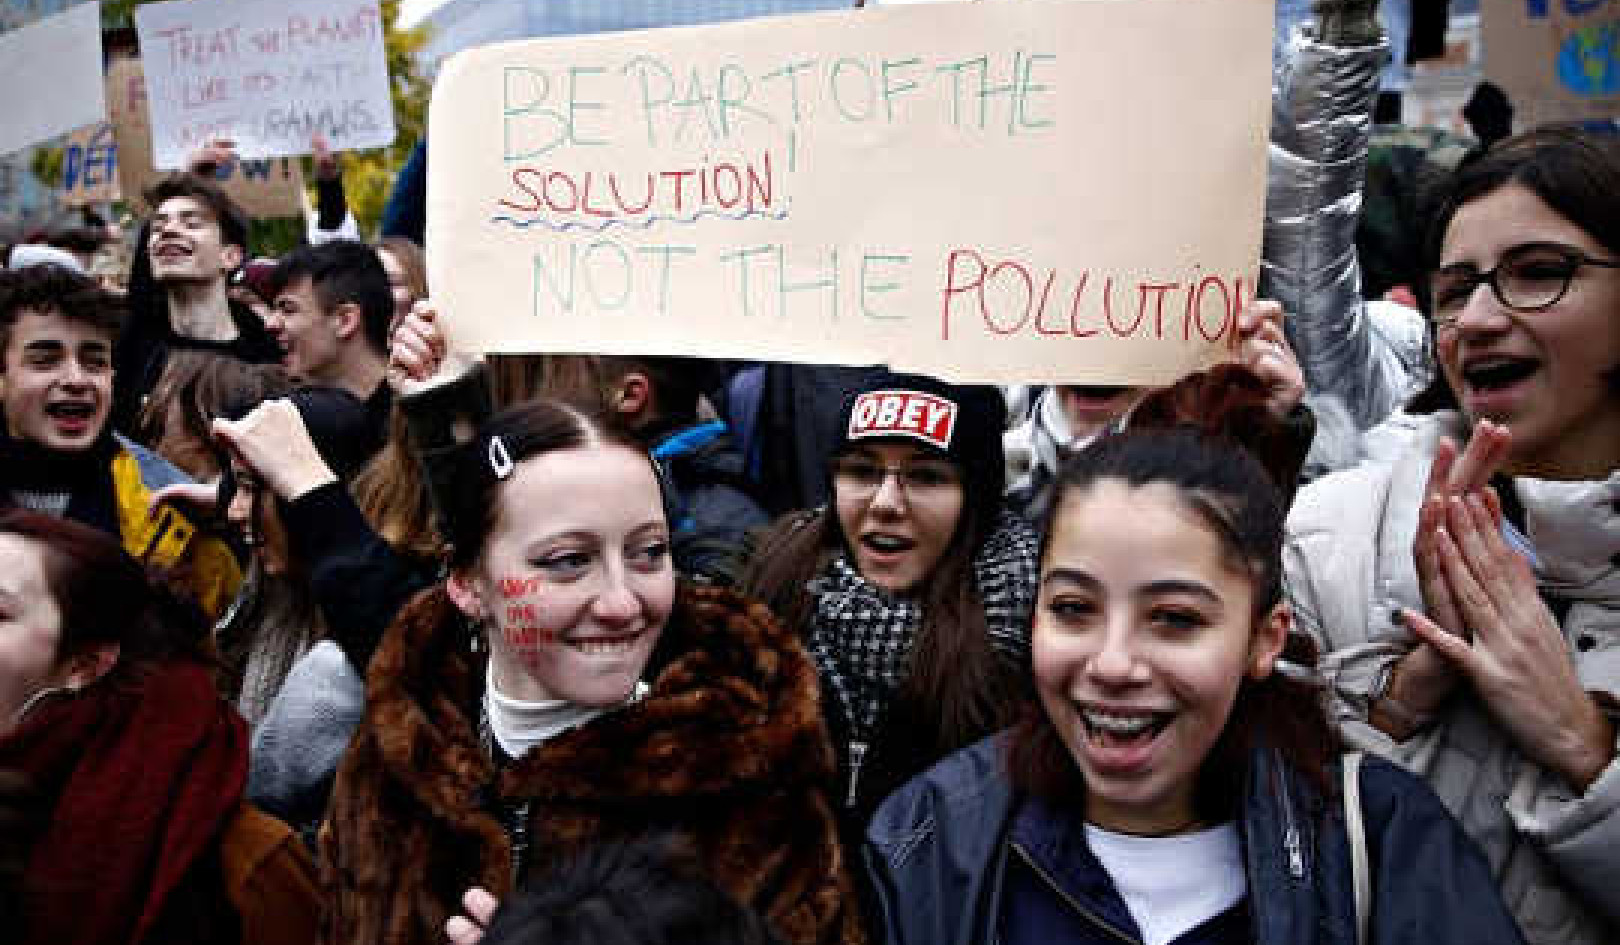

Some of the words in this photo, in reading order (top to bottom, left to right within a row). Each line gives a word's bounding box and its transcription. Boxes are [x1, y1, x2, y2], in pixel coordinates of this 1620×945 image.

[503, 65, 607, 162] BE
[623, 54, 818, 149] PART
[830, 57, 923, 124] OF
[934, 51, 1057, 136] THE
[533, 240, 697, 317] NOT
[719, 243, 909, 320] THE
[855, 396, 952, 435] OBEY
